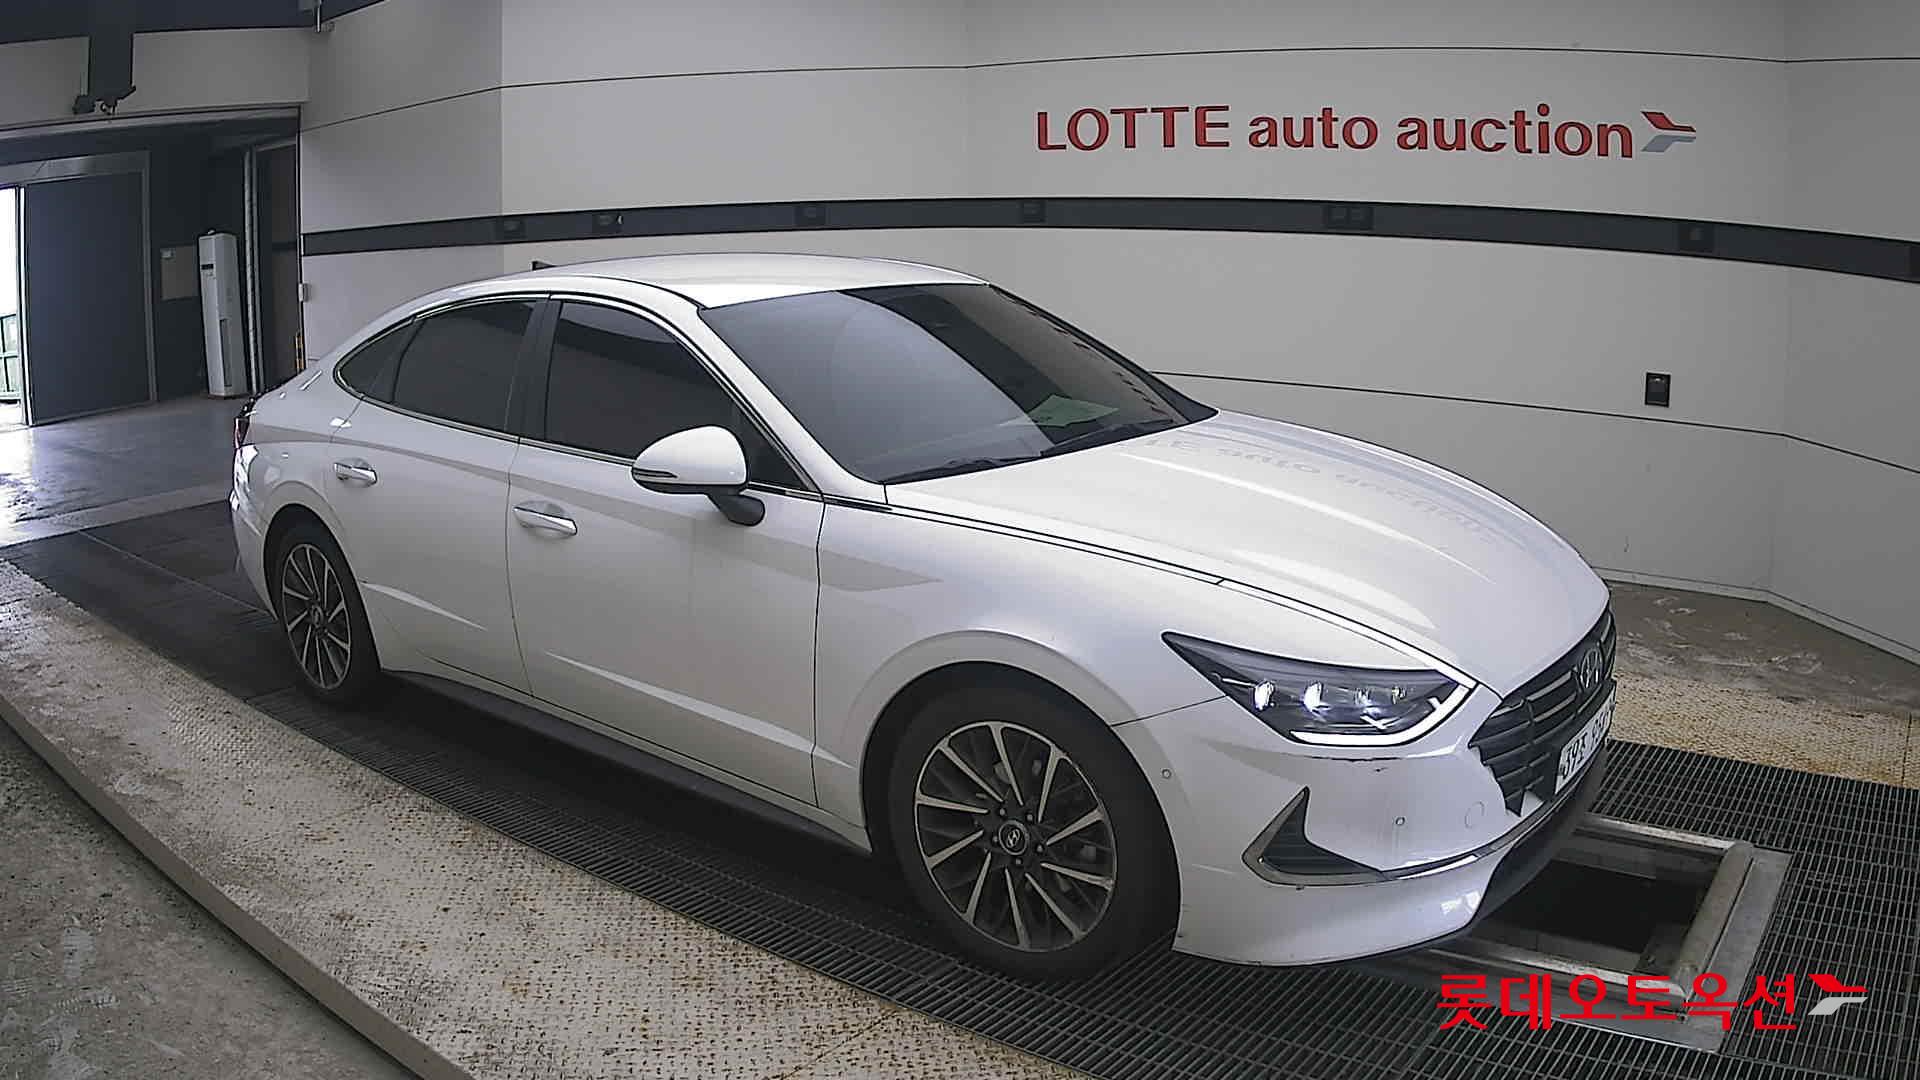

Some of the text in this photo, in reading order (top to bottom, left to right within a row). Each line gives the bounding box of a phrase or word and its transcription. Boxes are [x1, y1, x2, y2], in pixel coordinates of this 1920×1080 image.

[1036, 103, 1635, 159] LOTTE auto auction
